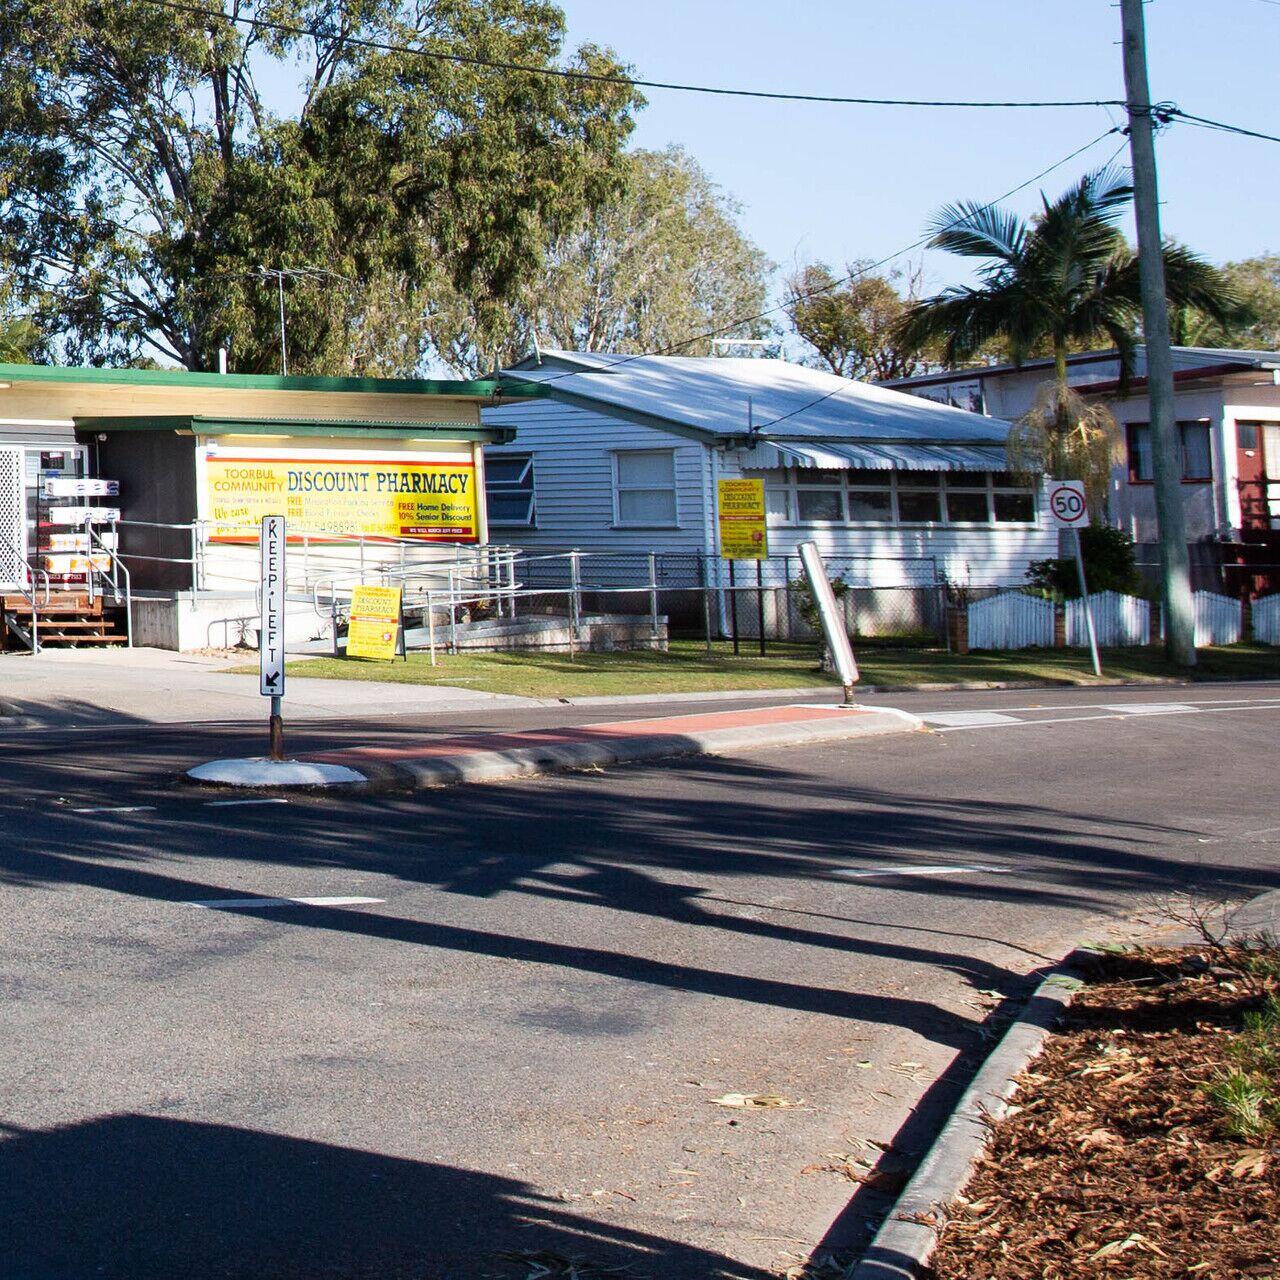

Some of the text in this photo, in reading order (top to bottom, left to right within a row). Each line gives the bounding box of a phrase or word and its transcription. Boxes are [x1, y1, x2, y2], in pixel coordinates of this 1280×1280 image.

[224, 468, 276, 480] TOORBUL
[213, 481, 284, 493] COMMUNITY
[287, 471, 469, 494] DISCOUNT PHARMACY
[287, 496, 302, 506] FREE
[1056, 496, 1081, 513] 50
[287, 507, 303, 517] FREE
[398, 502, 470, 513] FREE Home Delivery
[398, 511, 472, 521] 10% Senior Discount
[268, 524, 278, 663] KEEP LEFT
